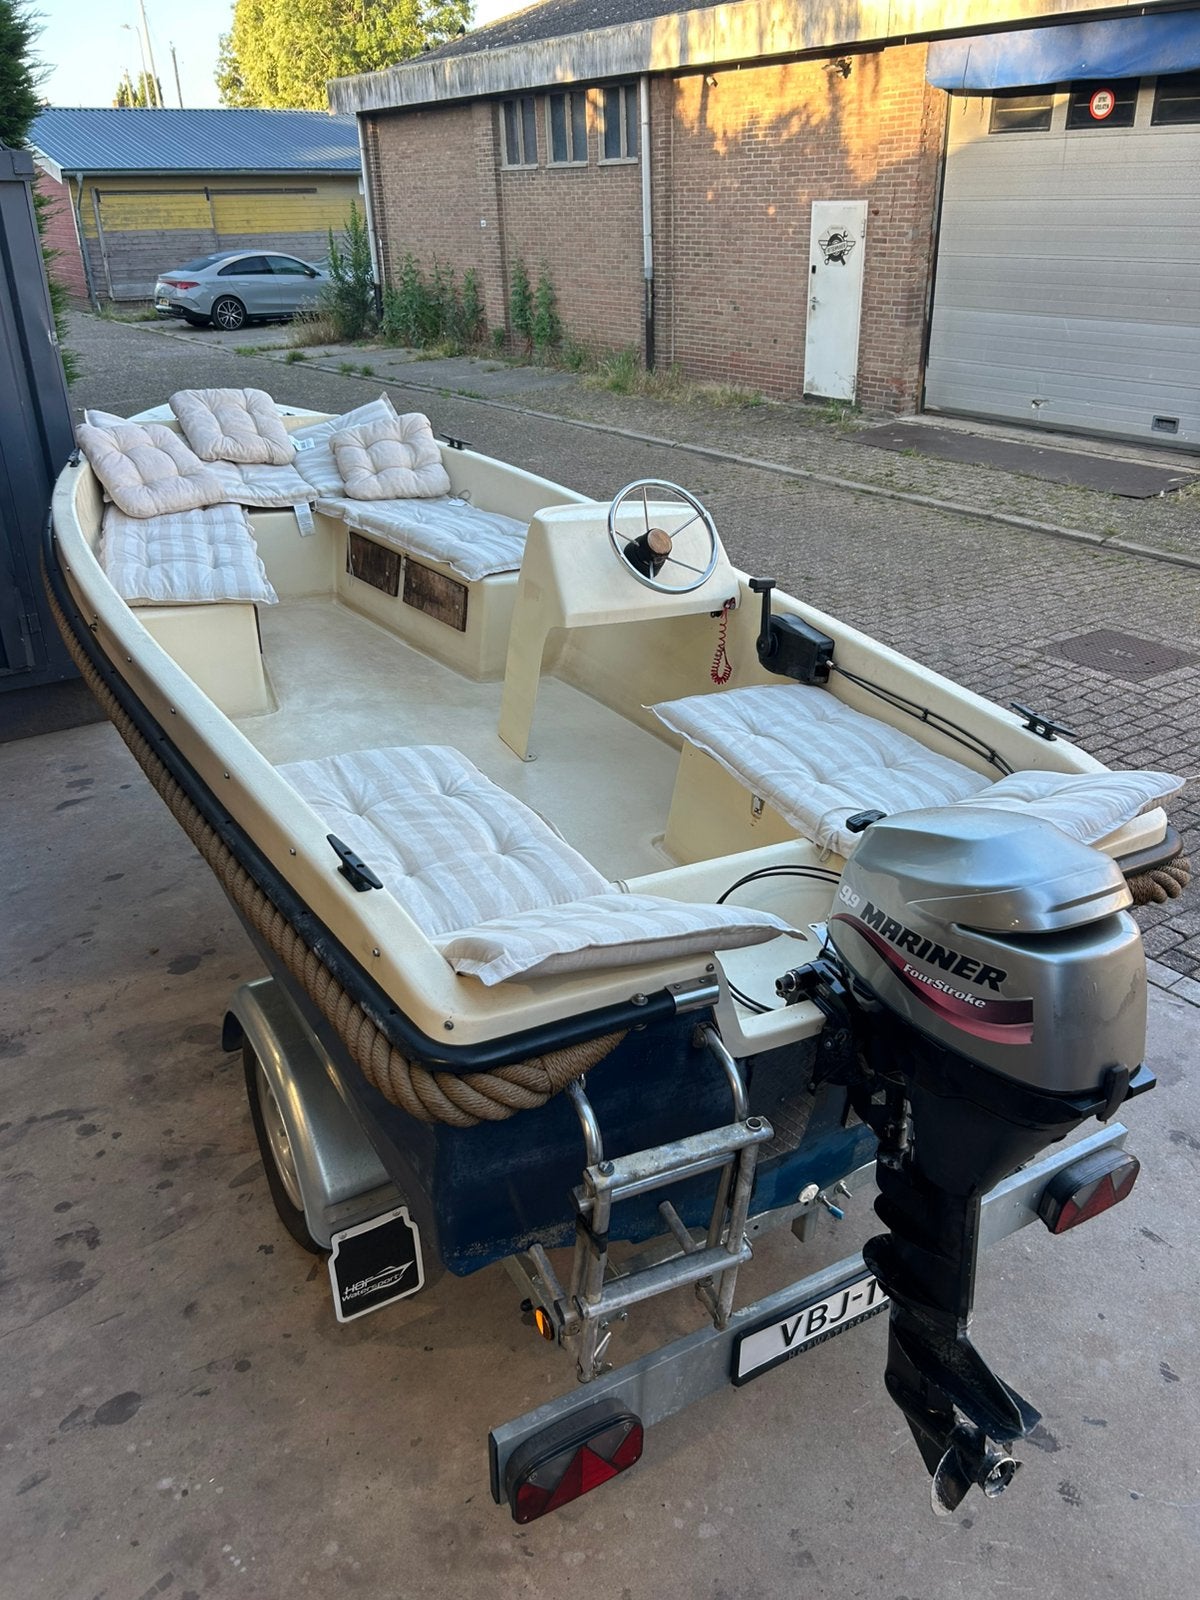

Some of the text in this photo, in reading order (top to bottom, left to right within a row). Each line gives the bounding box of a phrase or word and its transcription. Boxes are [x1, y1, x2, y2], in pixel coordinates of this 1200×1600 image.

[860, 902, 1007, 992] MARINER
[903, 964, 986, 1008] FourStroke
[781, 1278, 886, 1347] VBJ-1
